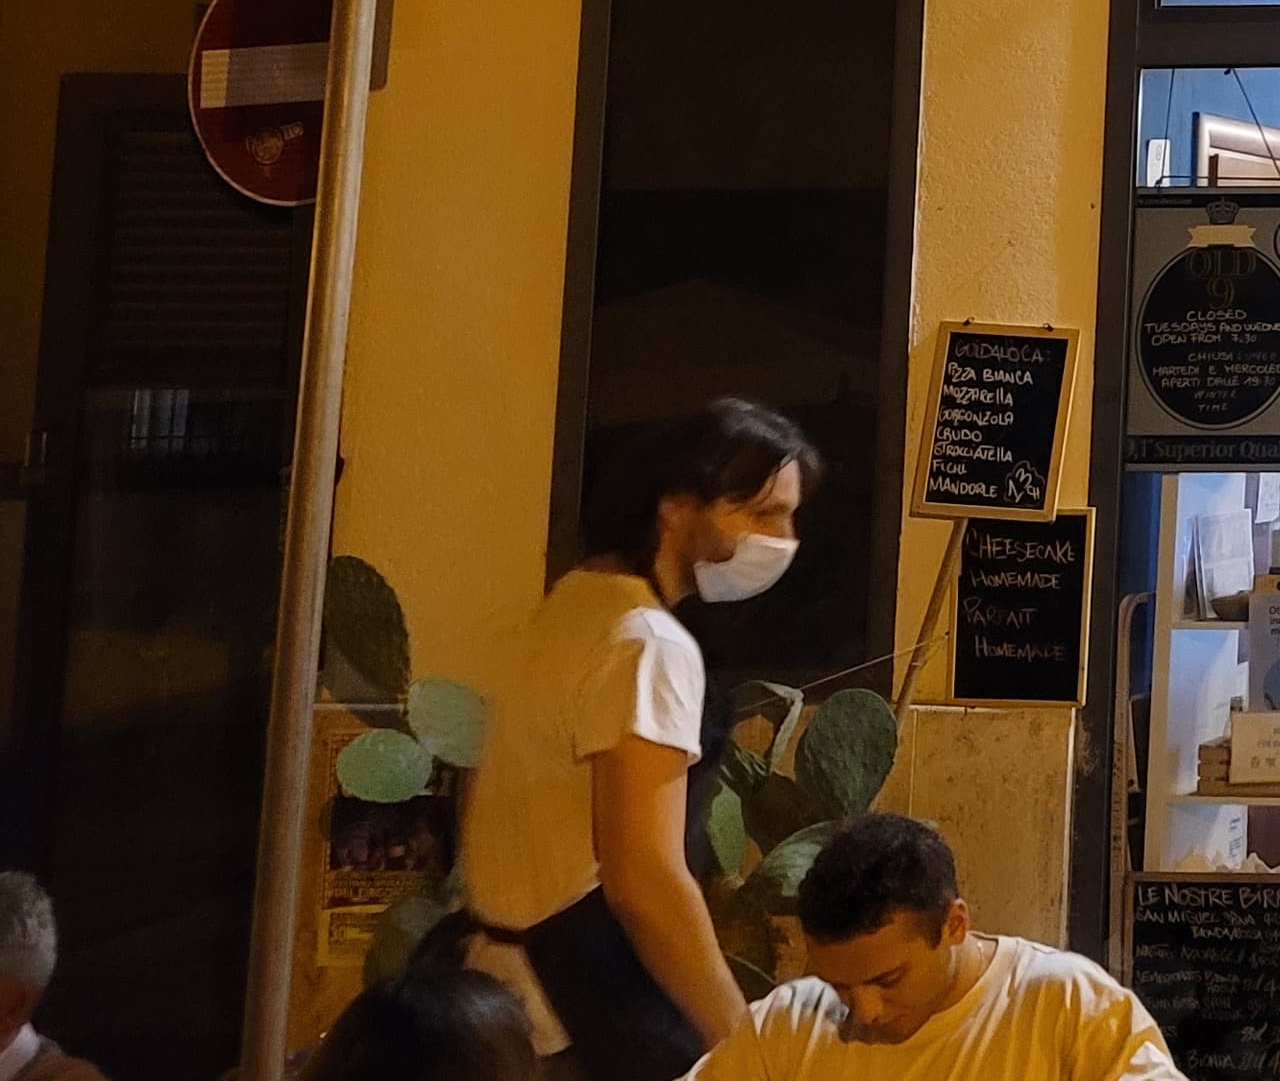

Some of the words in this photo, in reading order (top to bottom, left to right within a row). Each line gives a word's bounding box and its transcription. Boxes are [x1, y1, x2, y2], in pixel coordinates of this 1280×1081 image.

[1185, 246, 1258, 279] OLD
[1186, 309, 1247, 322] CLOSED
[1144, 322, 1216, 334] TUESDAYS
[1218, 323, 1242, 333] AND
[1151, 335, 1187, 347] OPEN
[1190, 334, 1222, 344] FROM
[1187, 351, 1233, 362] CHIUSI
[982, 367, 1034, 385] BIANCA
[936, 425, 983, 443] CRUDO
[1154, 439, 1237, 461] Superior
[965, 528, 1077, 565] CHEESECAKE
[969, 568, 1064, 590] HOMEMADE
[974, 632, 1066, 663] HOMEMADE
[1138, 885, 1160, 907] LE
[1163, 883, 1233, 909] NOSTRE
